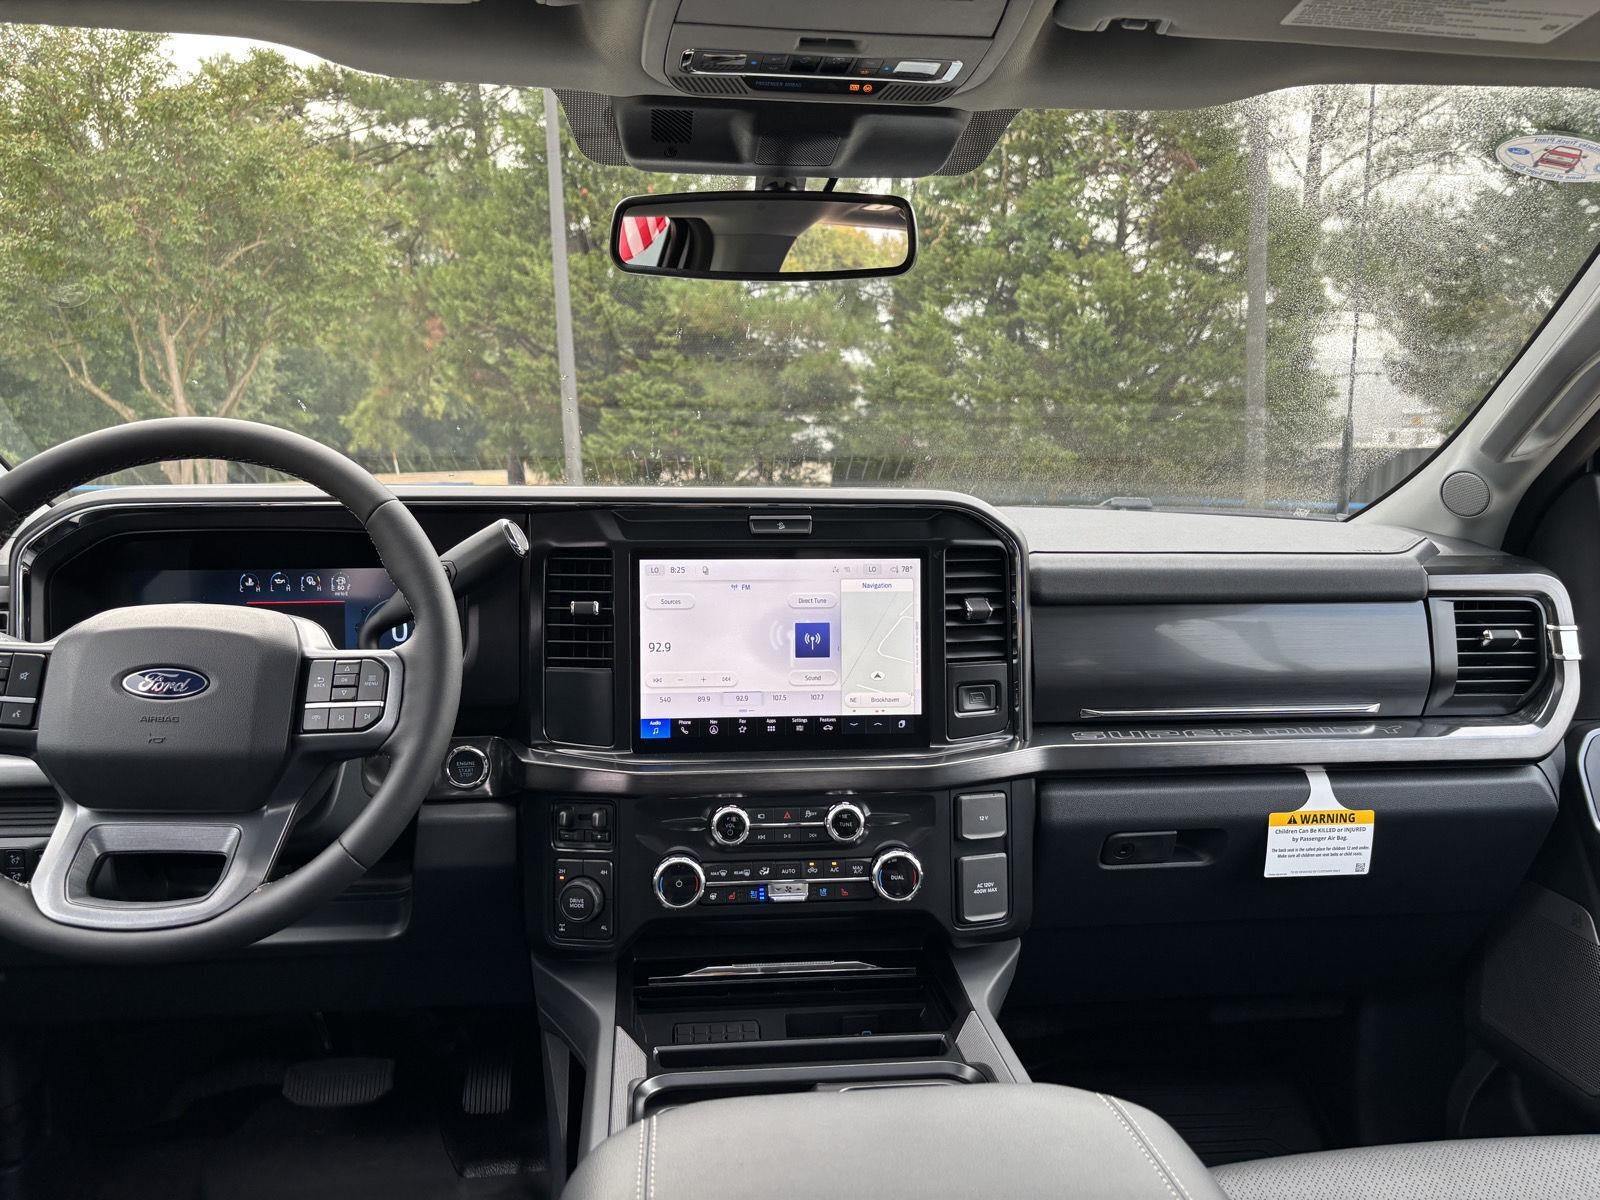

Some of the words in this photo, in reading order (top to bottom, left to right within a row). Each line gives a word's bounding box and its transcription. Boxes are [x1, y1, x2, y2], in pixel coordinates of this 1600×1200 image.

[670, 566, 686, 575] 8:25
[862, 582, 892, 590] Navigation
[660, 598, 682, 606] Sources
[798, 597, 812, 605] Direct
[812, 597, 827, 605] Tune
[648, 642, 672, 653] 92.9
[138, 672, 191, 694] Ford
[772, 694, 787, 702] 107.5
[870, 696, 900, 704] Brookhaven
[1071, 728, 1253, 741] SUPER
[1263, 725, 1402, 737] DUTY
[1300, 813, 1356, 824] WARNING
[1344, 826, 1367, 834] INJURED
